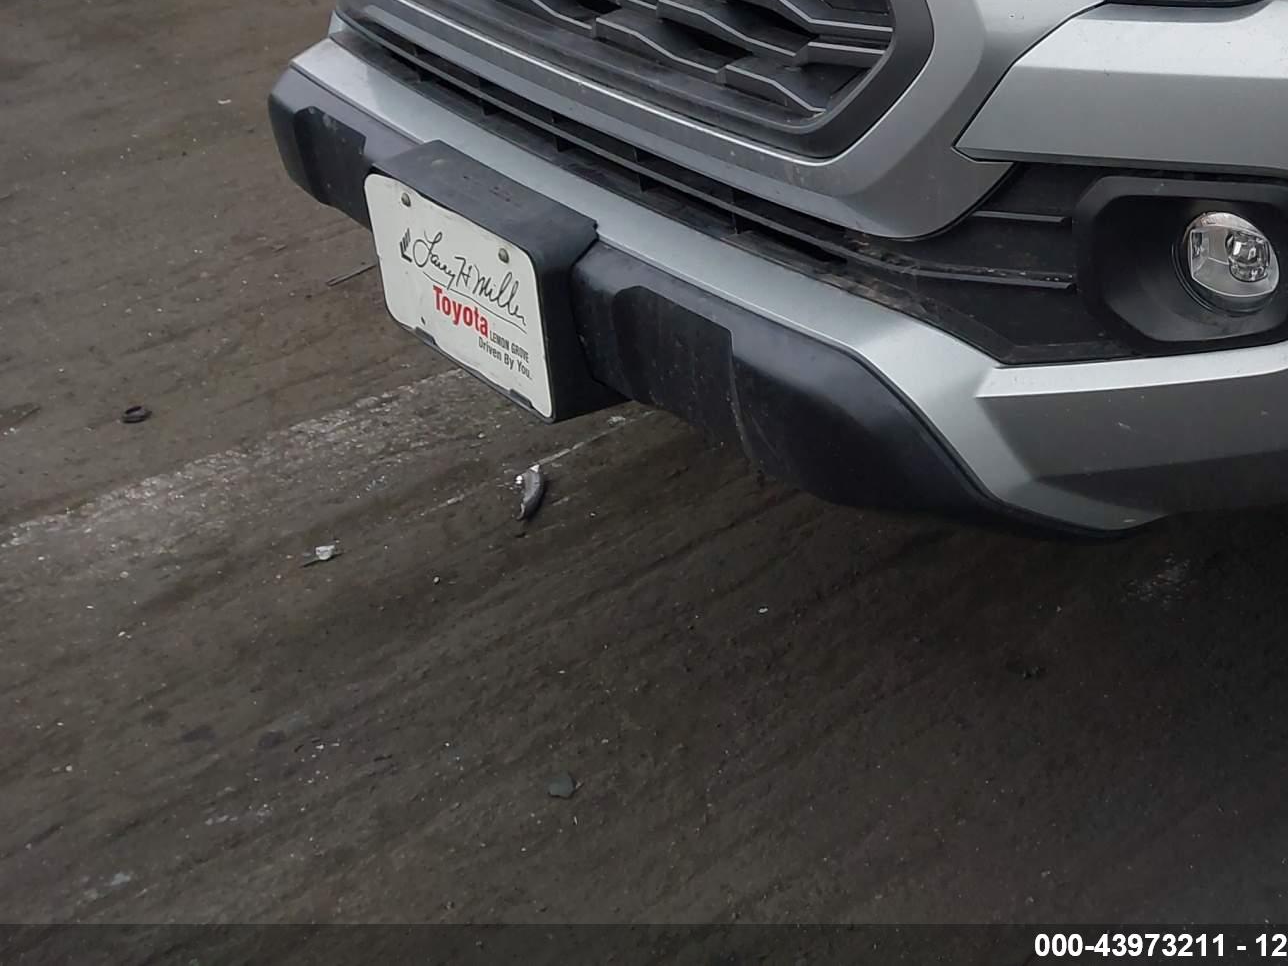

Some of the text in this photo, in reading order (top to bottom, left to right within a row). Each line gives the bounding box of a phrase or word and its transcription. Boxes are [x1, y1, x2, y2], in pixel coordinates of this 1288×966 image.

[433, 285, 489, 338] Toyota
[479, 336, 502, 362] Driven
[504, 353, 515, 370] By
